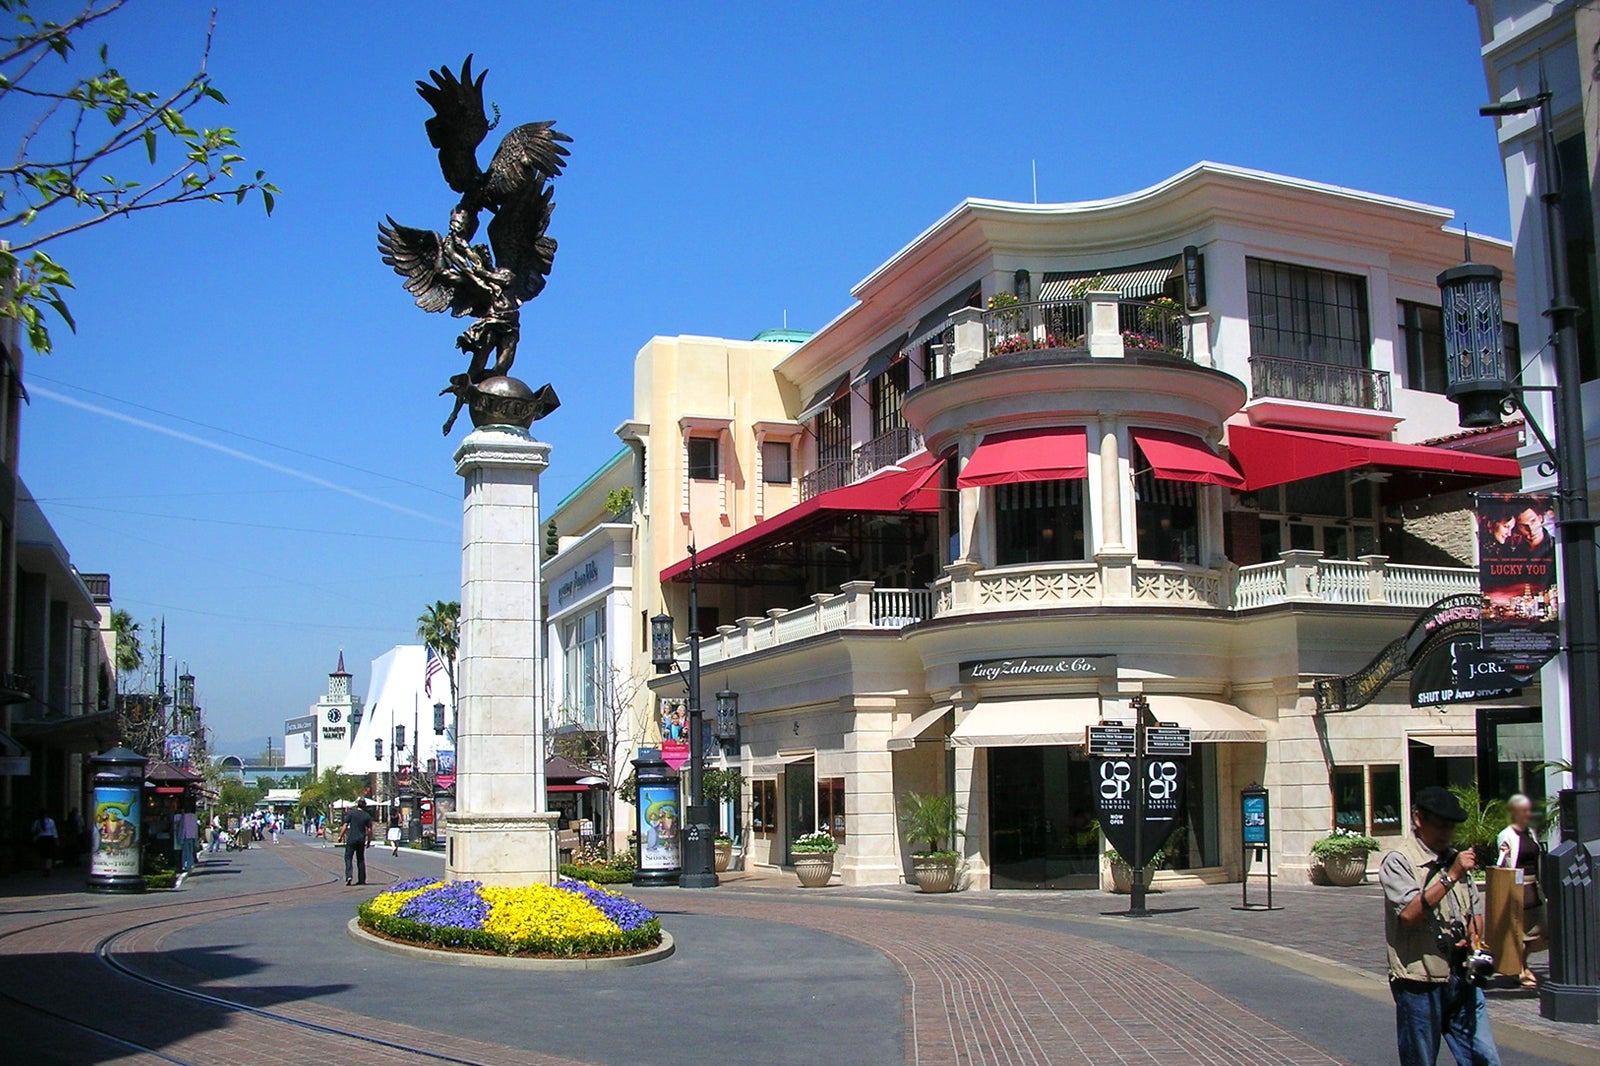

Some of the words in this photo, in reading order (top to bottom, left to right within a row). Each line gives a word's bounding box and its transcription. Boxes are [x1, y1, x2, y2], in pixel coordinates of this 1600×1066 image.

[1490, 564, 1523, 575] LUCKY
[1526, 564, 1546, 575] YOU
[971, 663, 1000, 680] Lucy
[1000, 660, 1054, 674] Zahran
[1055, 661, 1069, 671] &
[1070, 658, 1097, 672] Co.
[1418, 692, 1439, 703] SHUT
[1442, 690, 1454, 701] UP
[1100, 761, 1131, 780] CO
[1149, 761, 1177, 780] CO
[1100, 779, 1131, 799] OP
[1149, 779, 1177, 799] OP
